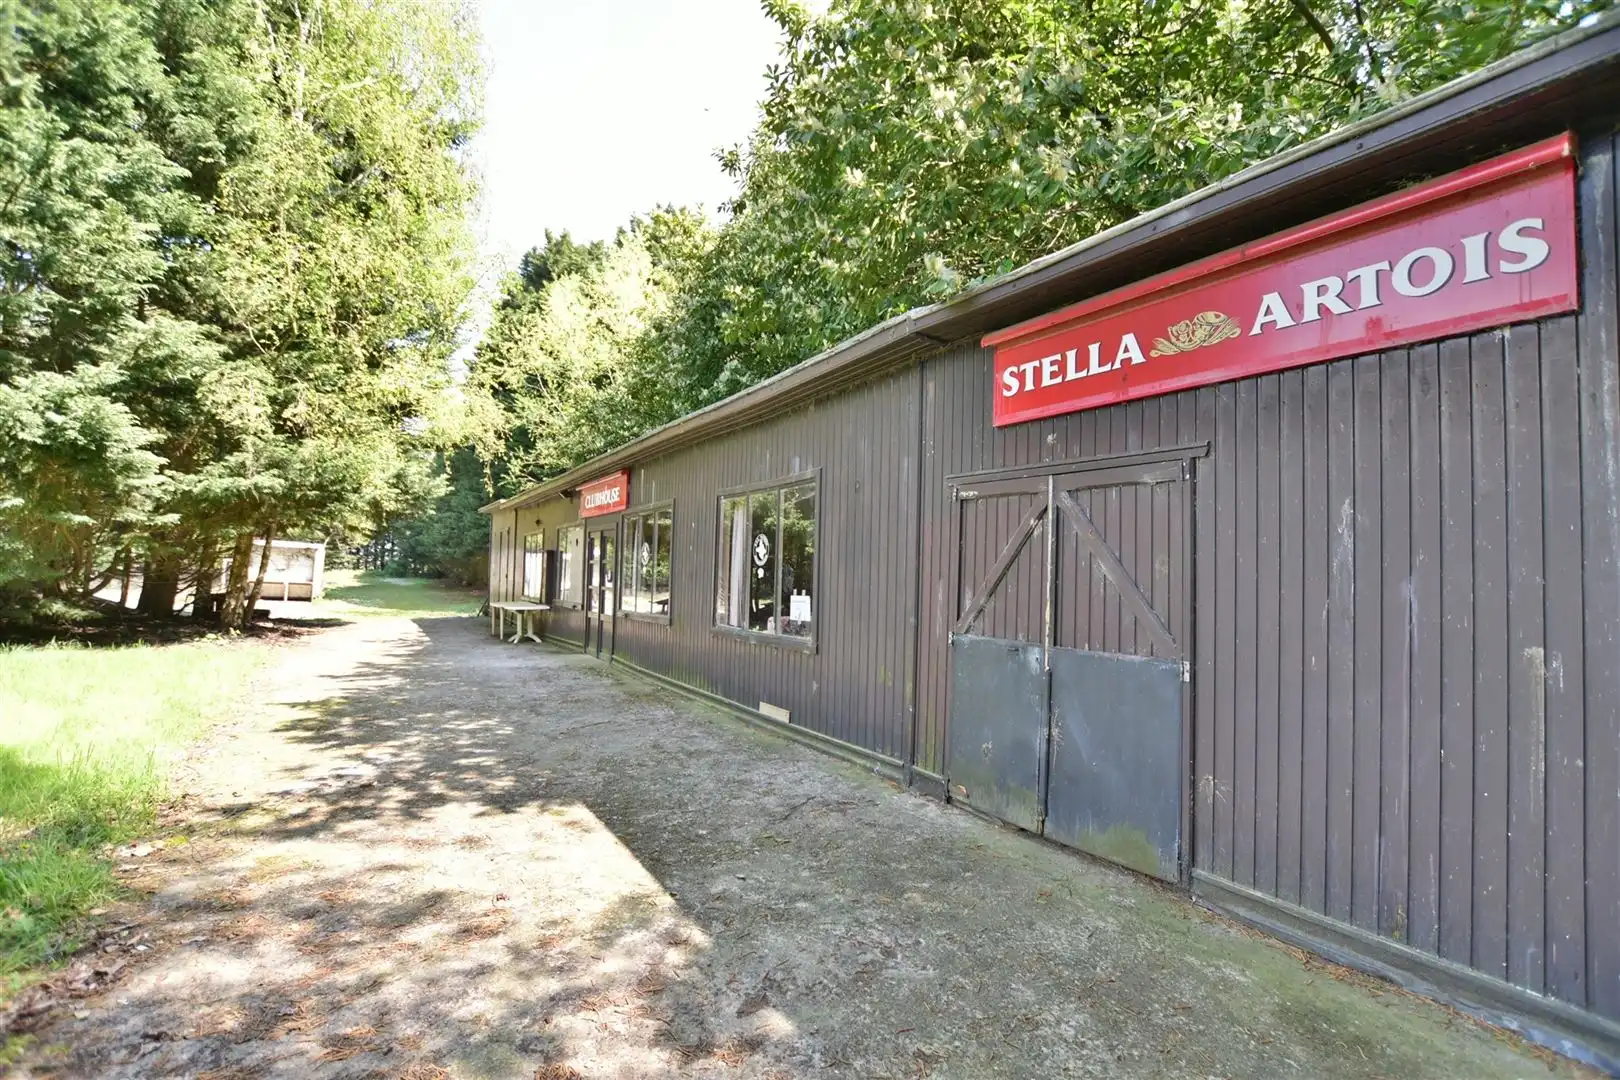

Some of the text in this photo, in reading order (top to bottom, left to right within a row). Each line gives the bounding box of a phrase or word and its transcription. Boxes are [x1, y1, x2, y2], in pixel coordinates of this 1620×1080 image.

[1001, 217, 1550, 398] STELLA ARTOIS
[585, 486, 621, 509] CLUBHOUSE
